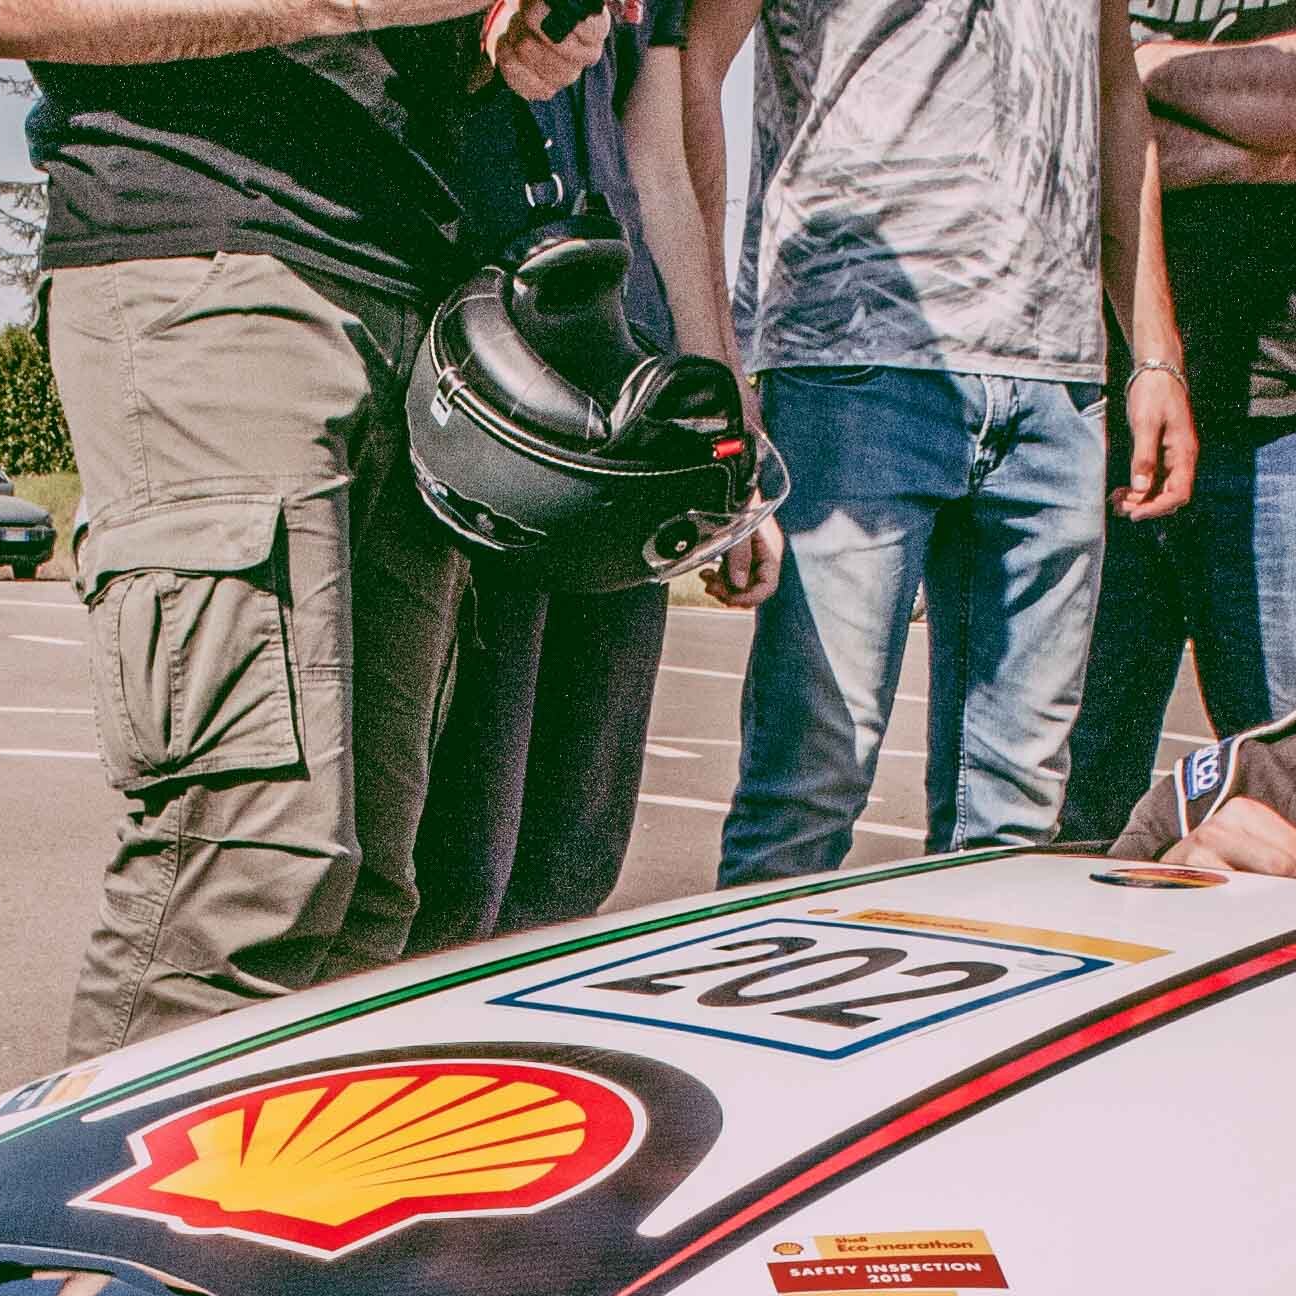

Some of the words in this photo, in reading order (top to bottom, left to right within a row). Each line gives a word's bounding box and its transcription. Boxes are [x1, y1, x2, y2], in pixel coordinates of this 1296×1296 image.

[583, 935, 1010, 1030] 202
[834, 1236, 868, 1244] Shell
[837, 1240, 974, 1253] Eco-marathon
[789, 1264, 858, 1278] SAFETY
[864, 1262, 982, 1274] INSPECTION
[867, 1273, 913, 1284] 2018
